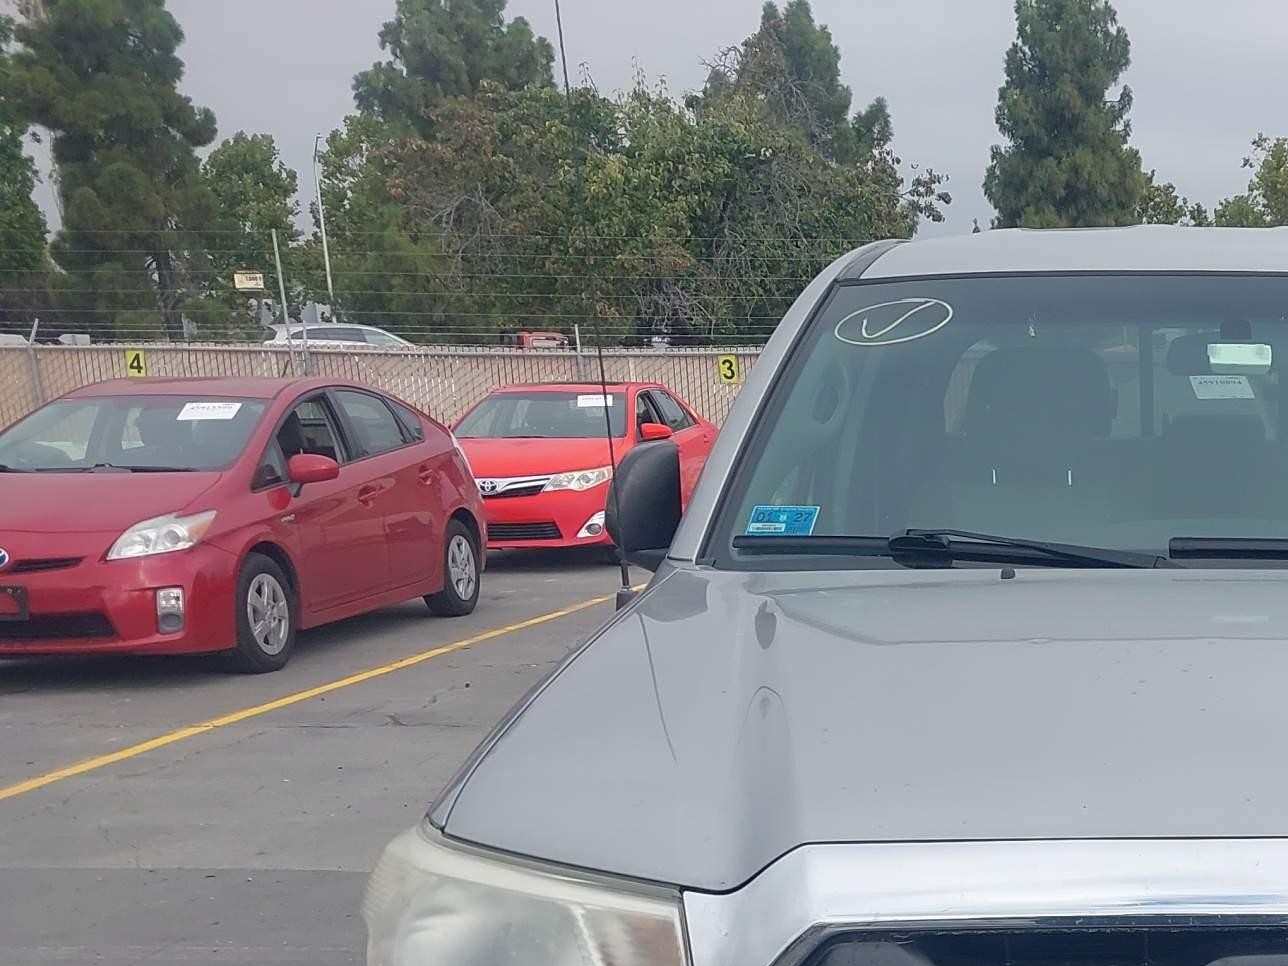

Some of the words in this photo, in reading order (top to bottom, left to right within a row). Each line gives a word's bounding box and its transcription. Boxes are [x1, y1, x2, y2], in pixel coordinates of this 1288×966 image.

[129, 353, 143, 374] 4
[722, 359, 735, 380] 3
[794, 512, 812, 522] 27
